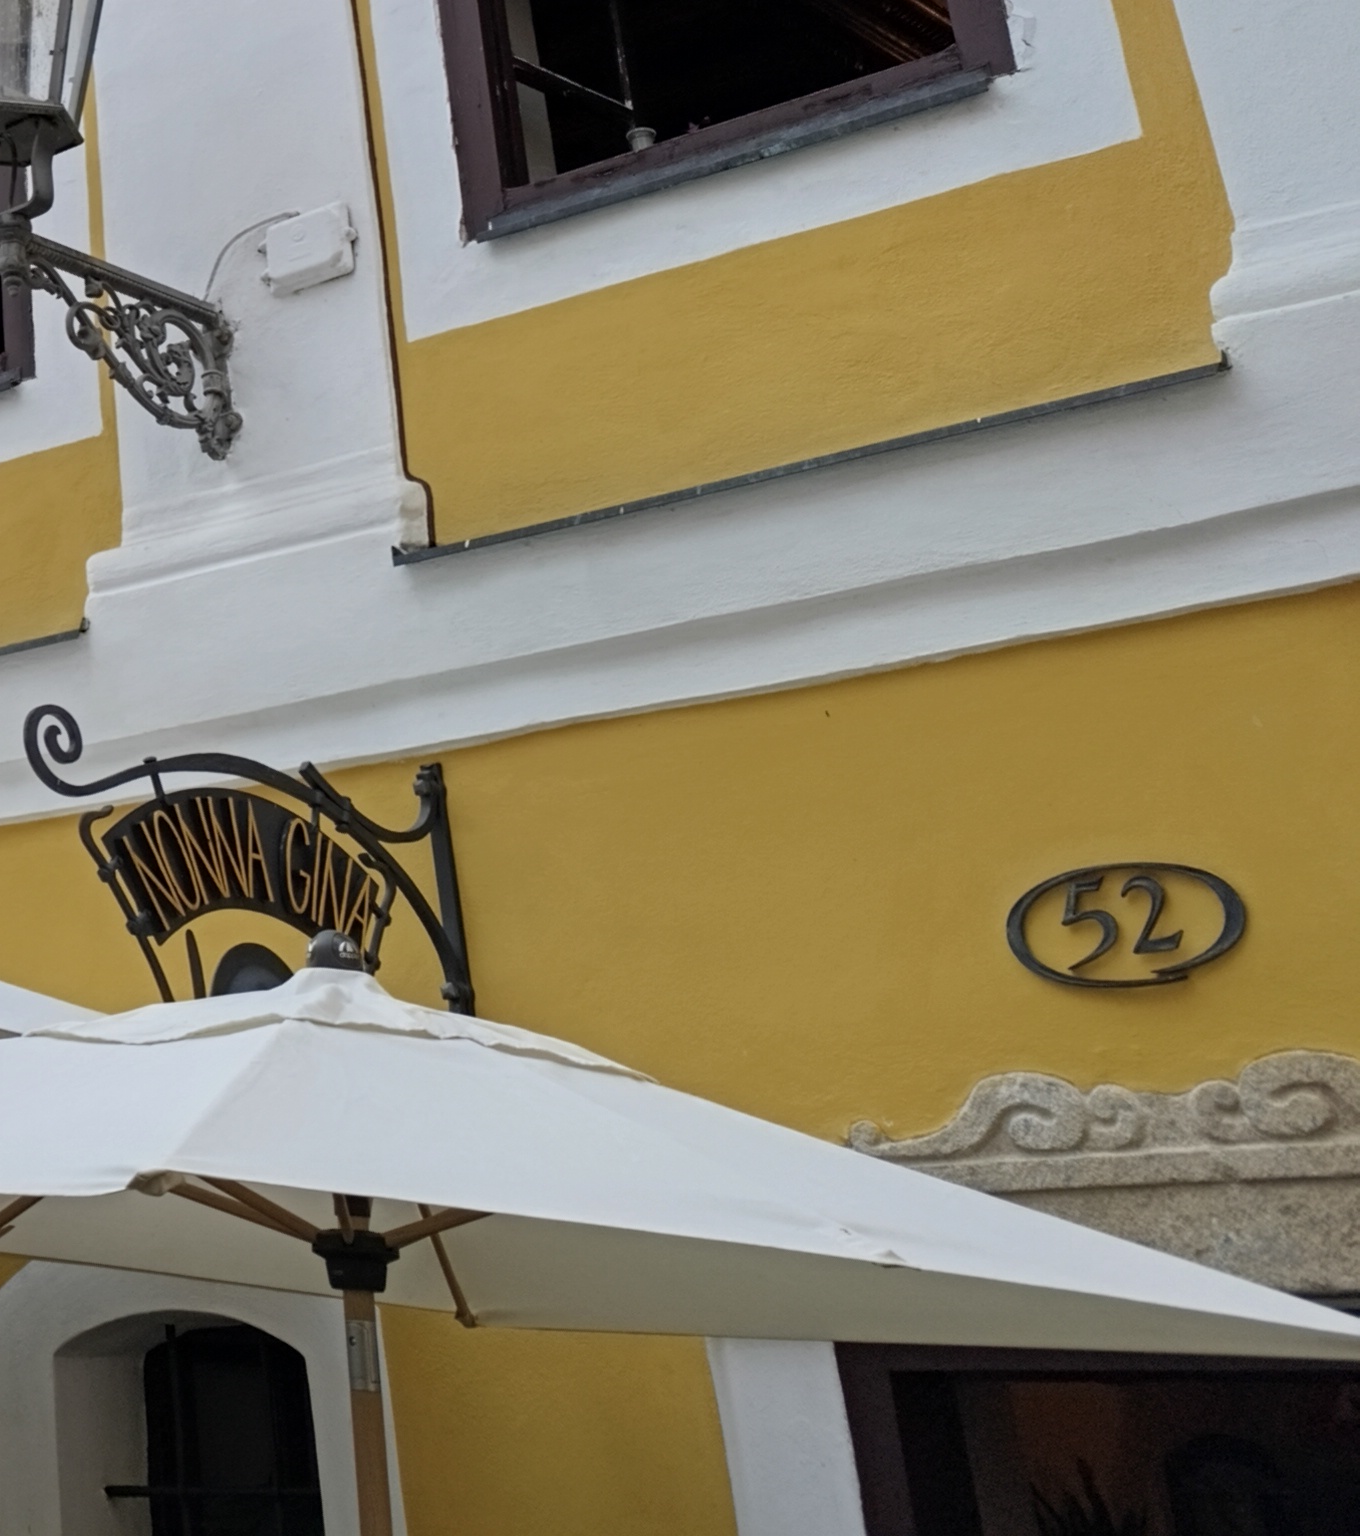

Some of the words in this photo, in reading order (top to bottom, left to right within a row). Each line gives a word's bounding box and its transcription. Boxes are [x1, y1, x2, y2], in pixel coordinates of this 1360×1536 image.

[123, 796, 274, 931] NONNA
[286, 818, 372, 937] GINA
[1061, 875, 1184, 971] 52
